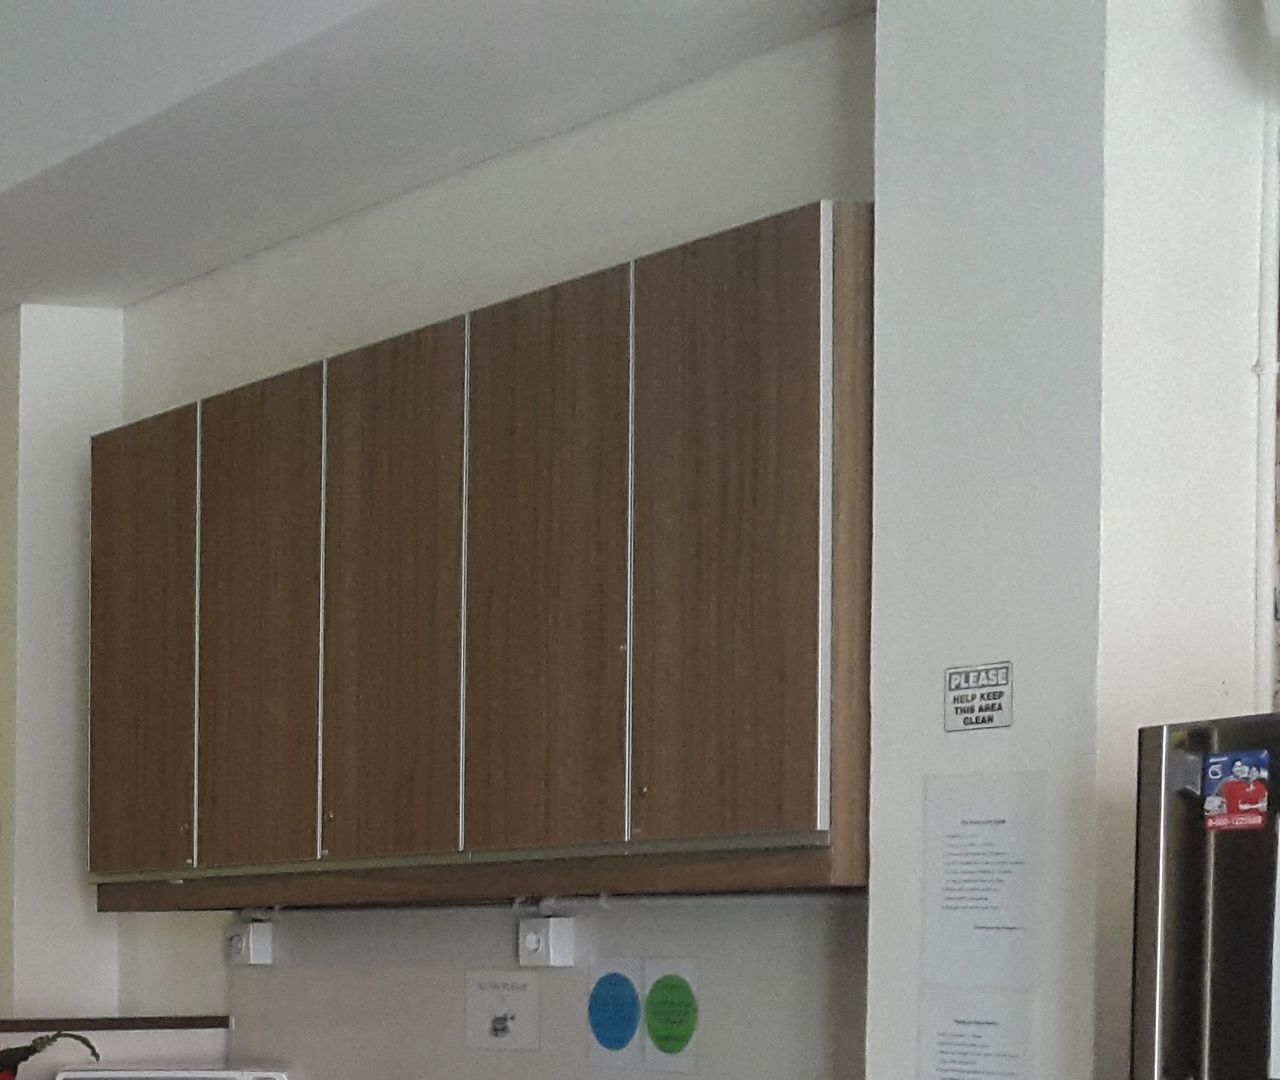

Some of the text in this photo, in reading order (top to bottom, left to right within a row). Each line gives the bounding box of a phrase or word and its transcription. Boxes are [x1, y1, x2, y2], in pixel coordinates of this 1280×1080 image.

[949, 668, 1008, 690] PLEASE
[953, 691, 1004, 704] HELP KEEP
[954, 703, 1002, 715] THIS AREA
[963, 715, 994, 725] CLEAN
